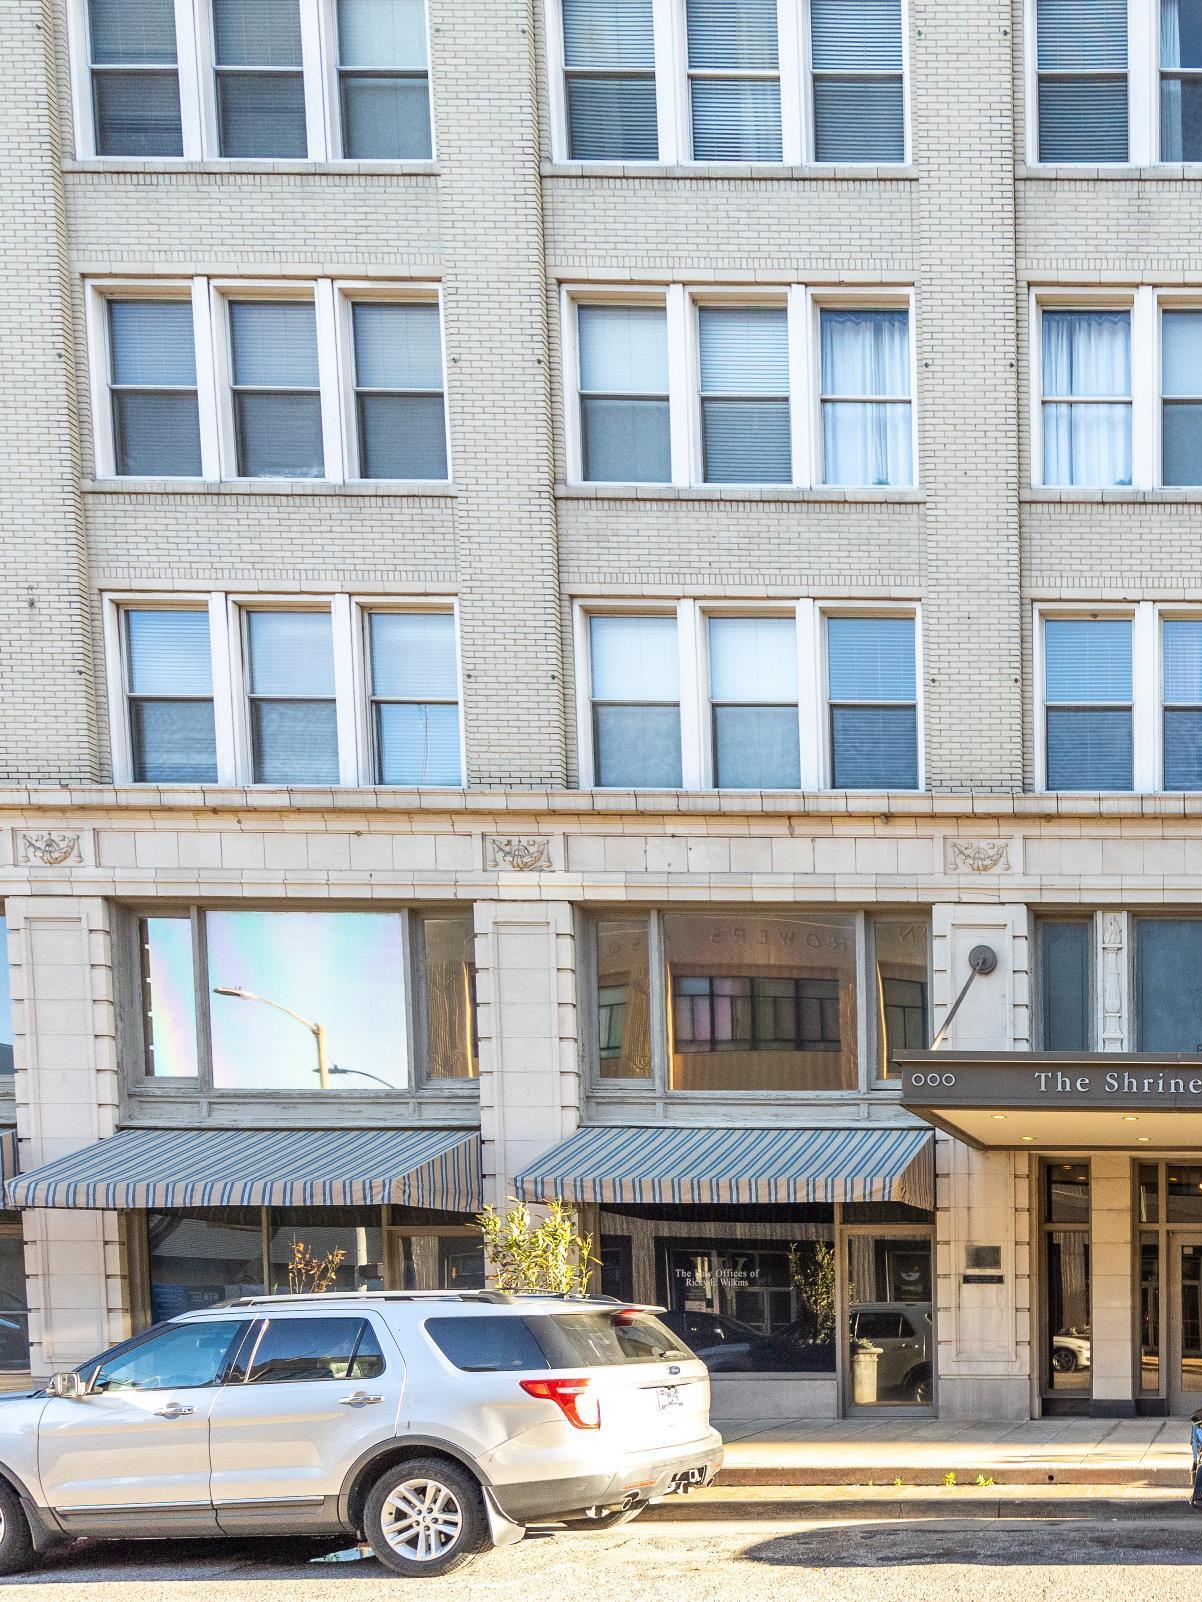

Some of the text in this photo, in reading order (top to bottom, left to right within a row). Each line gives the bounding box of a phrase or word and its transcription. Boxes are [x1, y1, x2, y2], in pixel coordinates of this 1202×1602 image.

[1034, 1071, 1090, 1092] The
[1105, 1071, 1202, 1094] Shrine
[674, 1268, 692, 1278] The
[716, 1268, 747, 1278] Offices
[749, 1268, 760, 1278] of
[685, 1278, 708, 1289] Ricky
[720, 1278, 749, 1288] Wilkins
